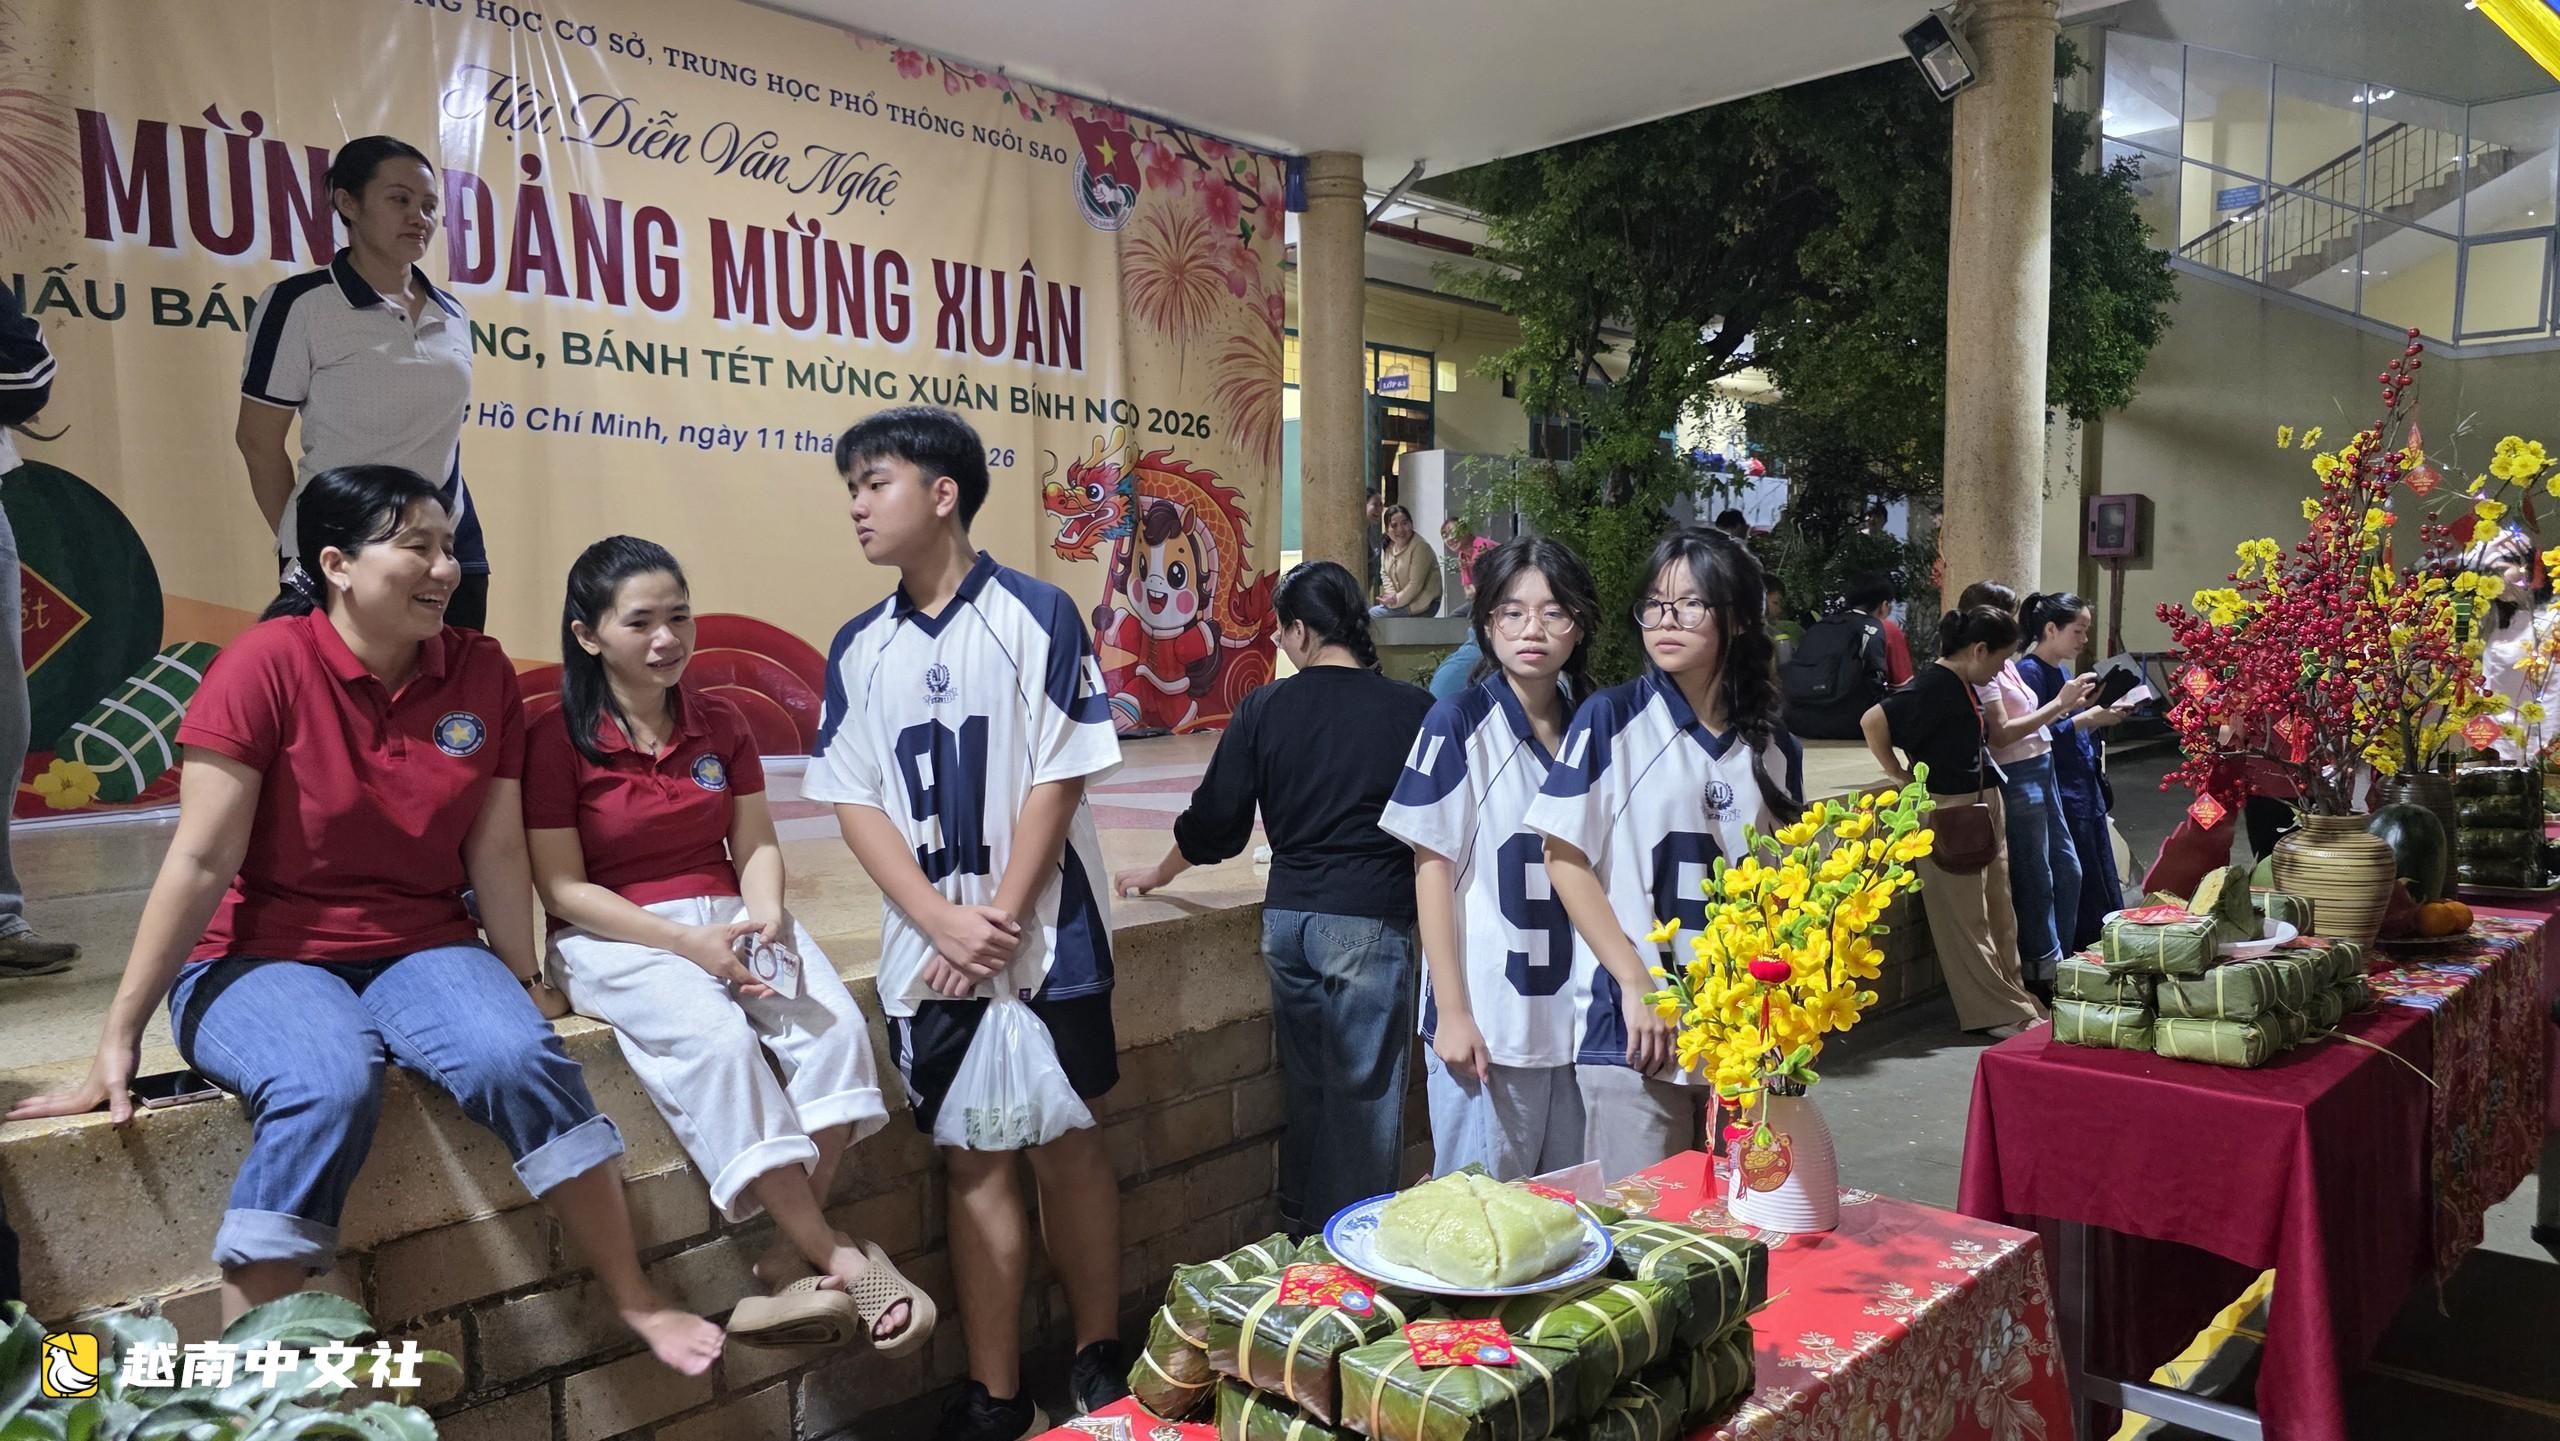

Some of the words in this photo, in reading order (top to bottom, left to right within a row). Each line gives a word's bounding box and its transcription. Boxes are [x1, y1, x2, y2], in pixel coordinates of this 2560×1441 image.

[443, 63, 559, 142] Hội
[560, 93, 692, 164] Diễn
[787, 144, 902, 216] Nghệ
[476, 0, 542, 32] HỌC
[555, 19, 597, 47] CƠ
[609, 32, 653, 64] SỞ,
[663, 46, 757, 86] TRUNG
[766, 72, 820, 102] HỌC
[829, 89, 878, 116] PHỔ
[886, 103, 965, 138] THÔNG
[972, 125, 1023, 153] NGÔI
[1029, 141, 1068, 164] SAO
[75, 103, 336, 267] MỪN
[440, 153, 681, 313] ĐẢNG
[708, 211, 911, 345] MỪNG
[931, 257, 1083, 371] XUÂN
[478, 400, 515, 429] Hồ
[526, 407, 583, 433] Chí
[591, 411, 669, 444] Minh,
[679, 423, 748, 451] ngày
[757, 427, 785, 449] 11
[795, 430, 834, 454] thá
[988, 447, 1015, 468] 26
[562, 329, 688, 378] BÁNH
[701, 345, 773, 386] TÉT
[786, 356, 898, 400] MỪNG
[908, 373, 998, 411] XUÂN
[1010, 382, 1074, 422] BÍNH
[1148, 407, 1211, 439] 2026
[895, 715, 991, 883] 91
